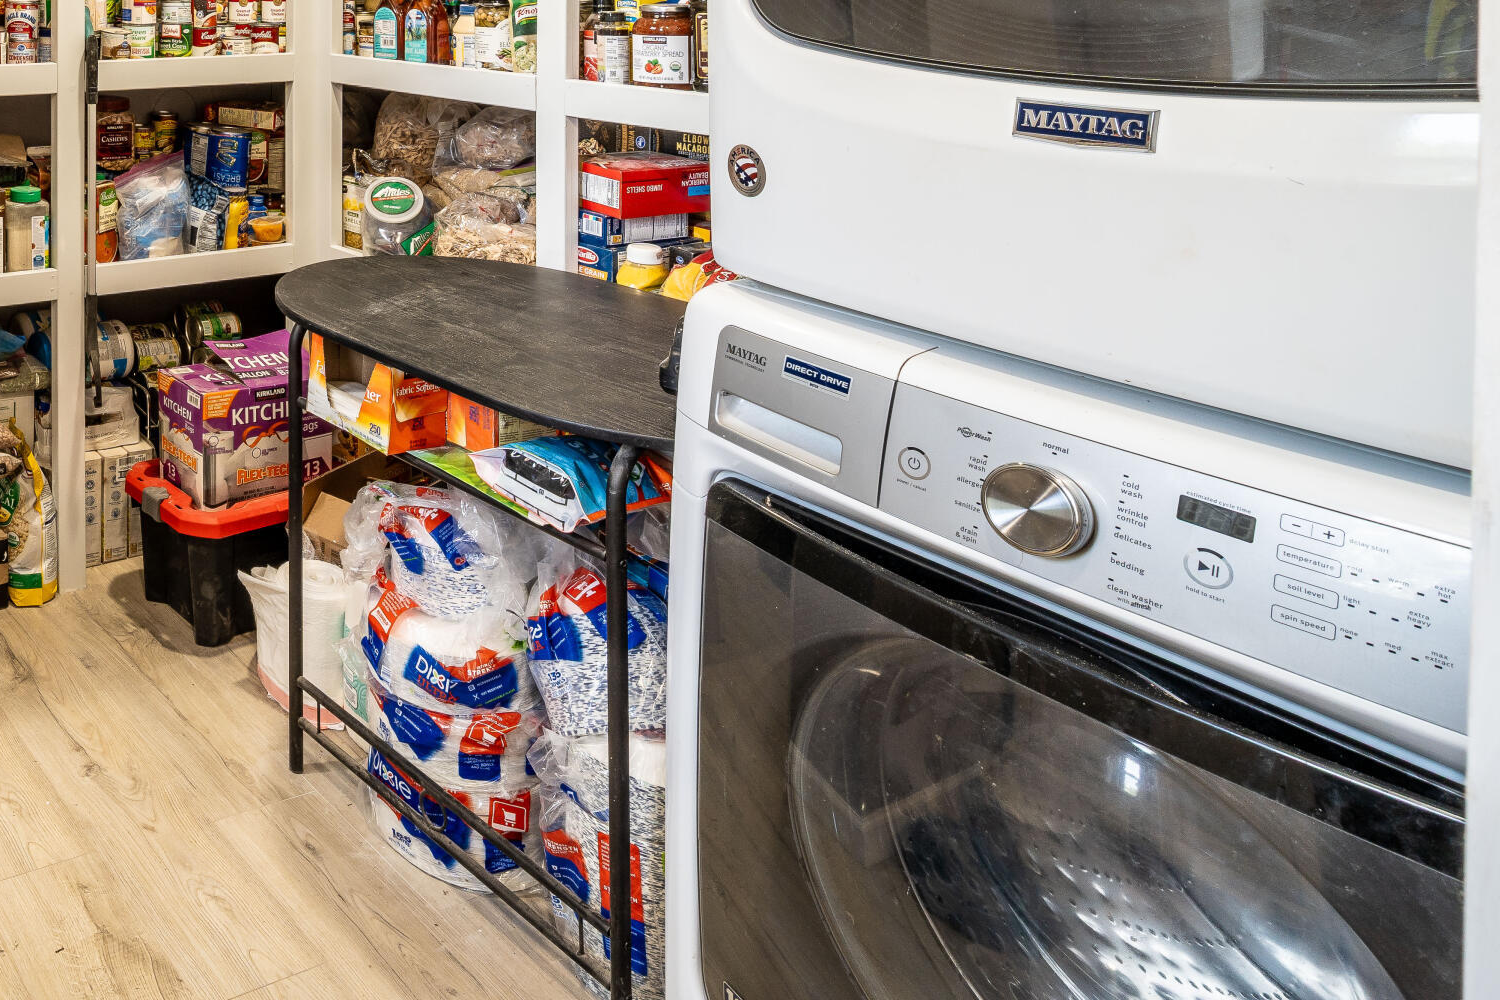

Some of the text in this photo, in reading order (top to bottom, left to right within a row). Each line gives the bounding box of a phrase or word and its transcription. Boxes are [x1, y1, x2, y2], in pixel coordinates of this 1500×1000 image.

[517, 3, 538, 16] Knor
[1021, 107, 1145, 141] MAYTAG
[101, 135, 128, 143] CASHEWS
[683, 134, 710, 144] ELBOW
[729, 146, 761, 166] AMERICA
[688, 171, 709, 180] BEAUTY
[626, 184, 663, 194] JUMBO SHELLS
[681, 179, 709, 187] AMERICAN
[578, 249, 597, 262] arilla
[584, 267, 605, 280] GRAIN
[725, 342, 767, 367] MAYTAG
[786, 361, 849, 389] DIRECT DRIVE
[256, 387, 286, 398] KIRKLAND
[395, 385, 415, 397] Fabric
[163, 395, 192, 422] KITCHEN
[232, 401, 289, 426] KITCH
[302, 420, 318, 433] ags
[369, 422, 381, 436] 250
[162, 435, 197, 473] FLEX-TECH
[1041, 441, 1070, 454] normal
[304, 460, 320, 475] 13
[969, 455, 988, 467] rapid
[167, 462, 176, 476] 13
[968, 463, 986, 473] wash
[236, 464, 289, 486] FLEX-TEC
[1121, 480, 1140, 491] cold
[1120, 488, 1143, 500] wash
[1186, 490, 1218, 504] estimated
[1218, 500, 1235, 510] cycle
[954, 500, 981, 513] sanitize
[1117, 505, 1149, 521] wrinkle
[1116, 514, 1146, 528] control
[960, 525, 978, 538] drain
[962, 534, 977, 544] spin
[1113, 531, 1152, 550] delicates
[1110, 556, 1145, 576] bedding
[1283, 550, 1335, 571] temperature
[1106, 582, 1164, 609] clean washer
[1185, 584, 1200, 595] hold
[1208, 594, 1225, 604] start
[1287, 582, 1325, 600] soil level
[1434, 584, 1456, 595] extra
[1437, 590, 1452, 600] hot
[1343, 594, 1361, 605] light
[1280, 612, 1326, 632] spin speed
[1406, 614, 1432, 628] heavy
[1408, 610, 1430, 621] extra
[1339, 626, 1359, 637] none
[1384, 641, 1402, 651] med
[1424, 654, 1455, 669] extract
[1430, 650, 1449, 661] max
